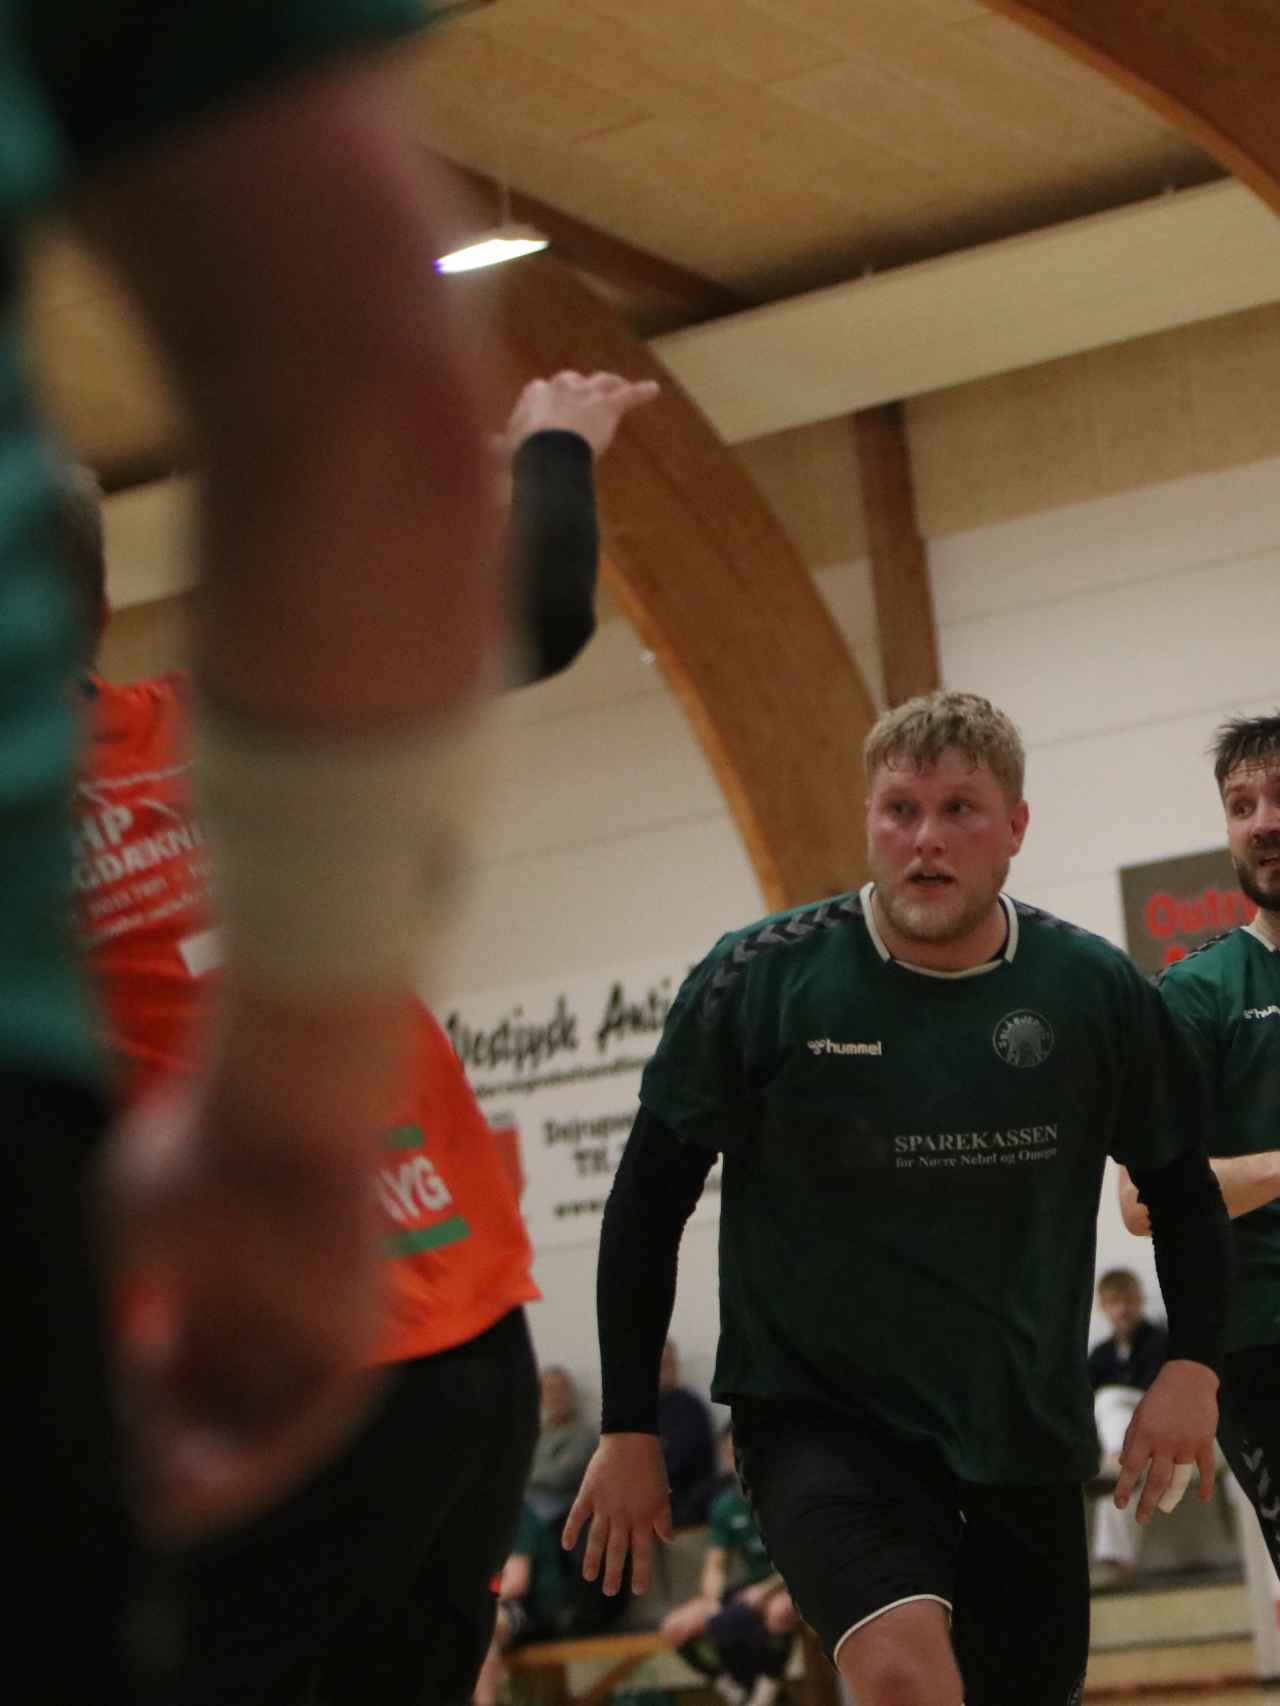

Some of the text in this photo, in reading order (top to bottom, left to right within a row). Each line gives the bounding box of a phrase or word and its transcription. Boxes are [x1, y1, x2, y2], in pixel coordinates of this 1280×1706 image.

[825, 1038, 882, 1056] hummel
[895, 1123, 1059, 1153] SPAREKASSEN
[896, 1156, 913, 1169] for
